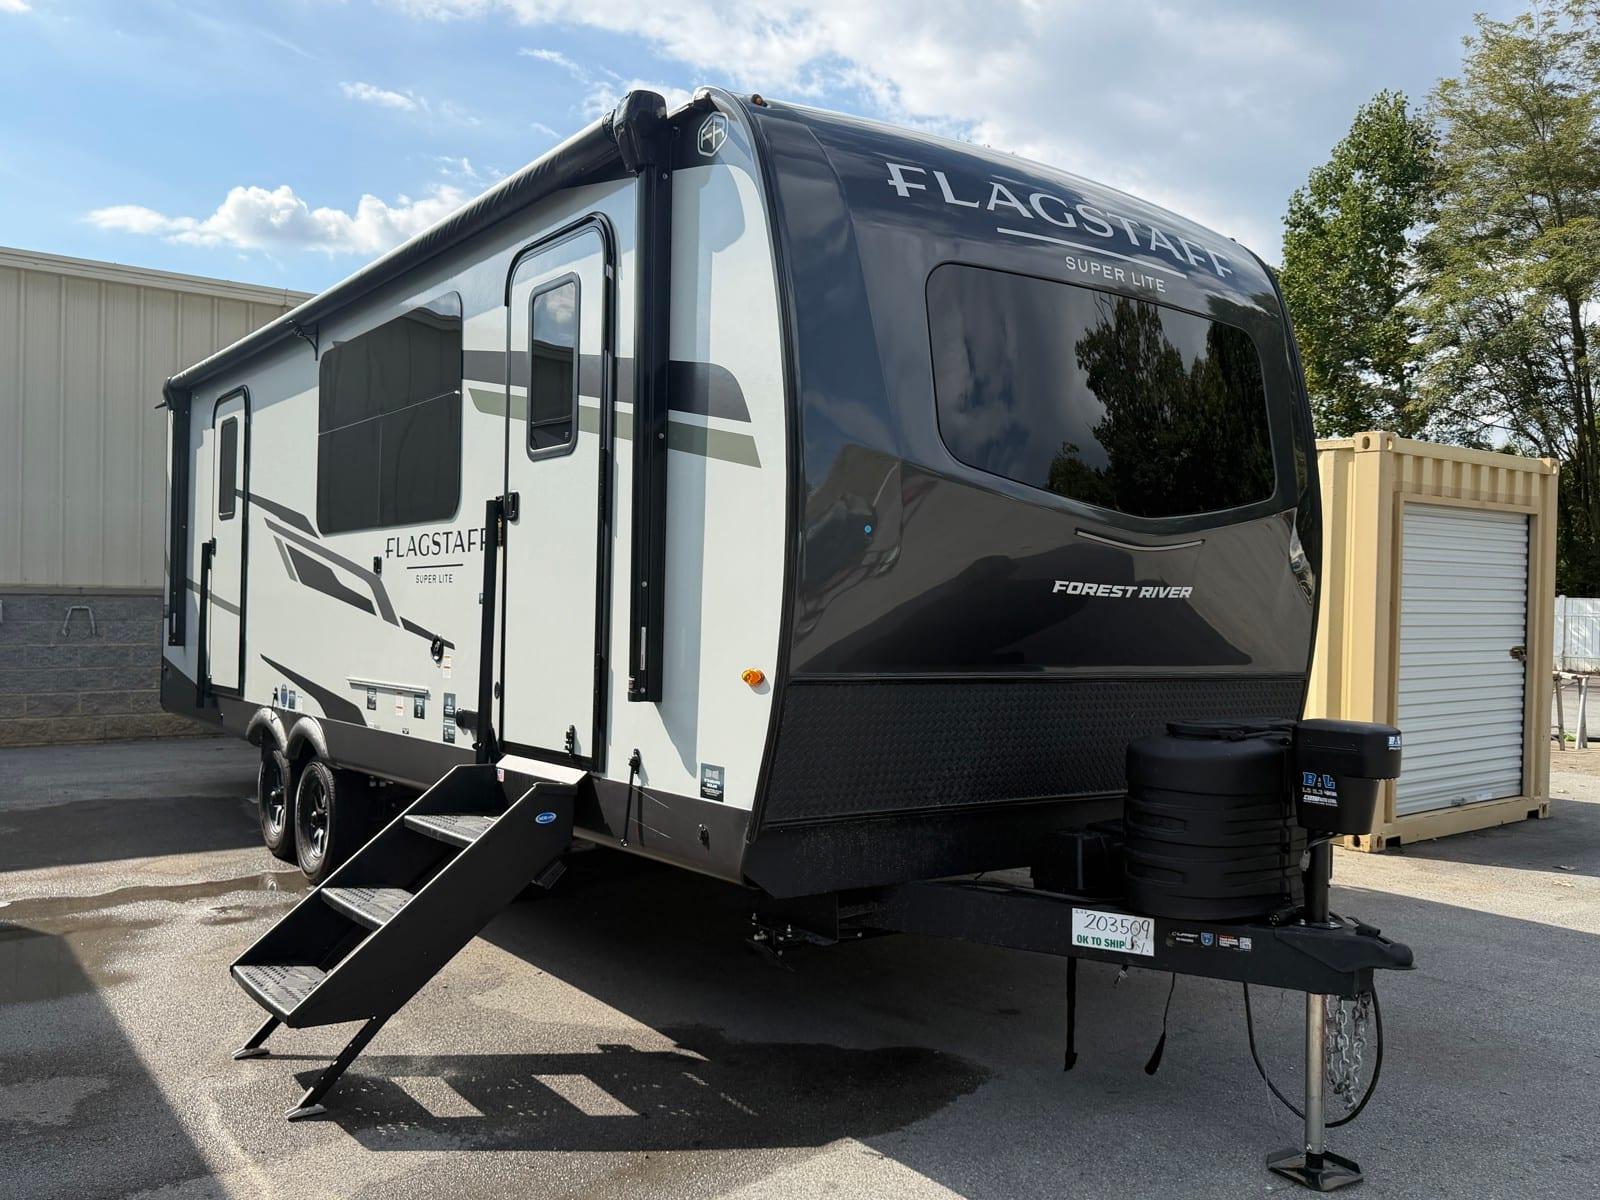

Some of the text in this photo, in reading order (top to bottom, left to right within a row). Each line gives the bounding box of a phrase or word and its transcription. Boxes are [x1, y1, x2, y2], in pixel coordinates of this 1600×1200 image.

[885, 161, 1233, 278] FLAGSTAFF
[1064, 256, 1166, 293] SUPER LITE
[386, 528, 486, 558] FLAGSTAFF
[415, 573, 453, 584] SUPER LITE
[1052, 580, 1194, 599] FOREST RIVER
[1084, 913, 1150, 940] 203509
[1076, 934, 1089, 944] OK
[1091, 936, 1102, 946] TO
[1104, 938, 1125, 949] SHIP
